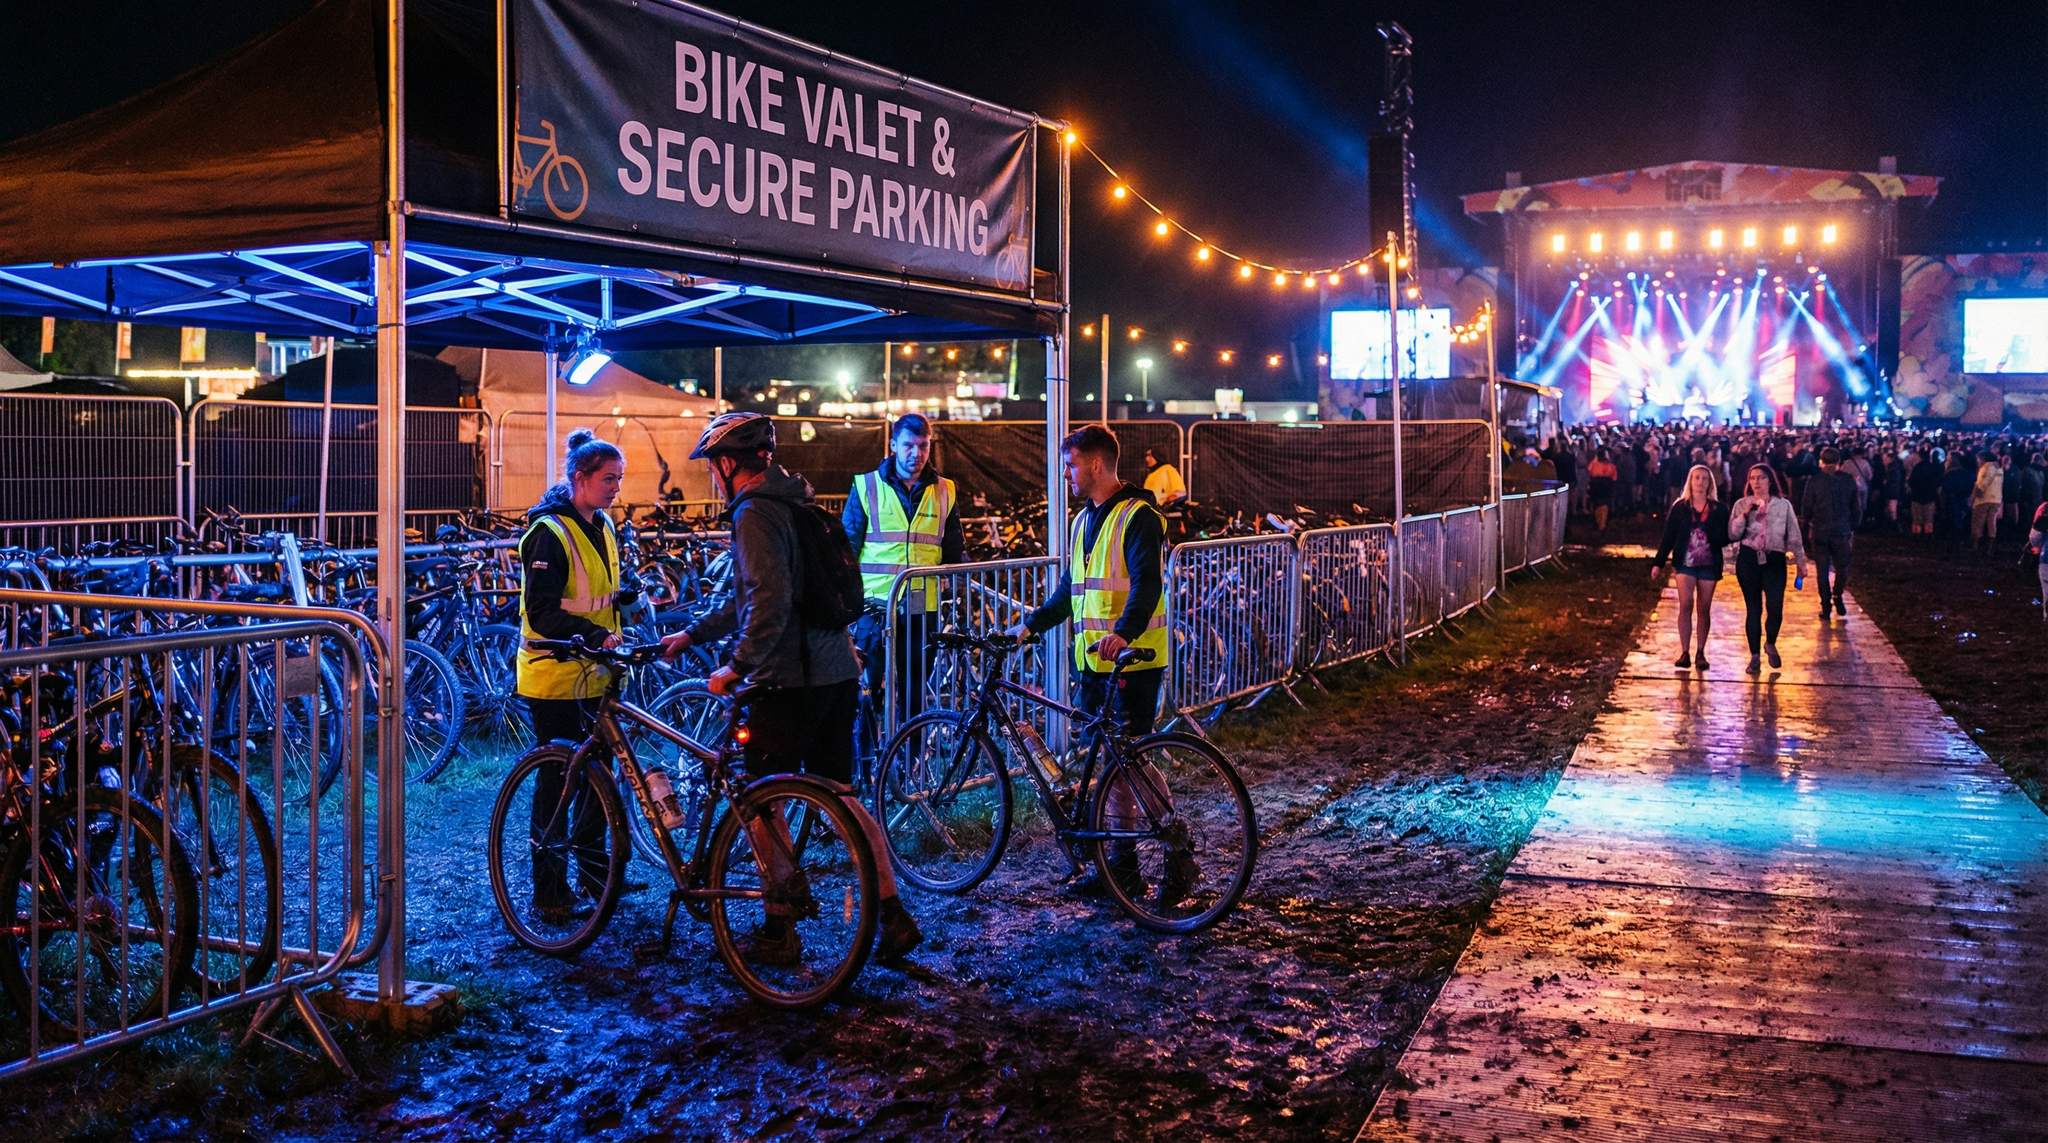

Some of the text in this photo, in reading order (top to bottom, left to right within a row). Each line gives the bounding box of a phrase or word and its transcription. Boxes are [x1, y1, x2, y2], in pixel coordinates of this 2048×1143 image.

[675, 41, 956, 178] BIKE VALET &
[617, 120, 988, 256] SECURE PARKING
